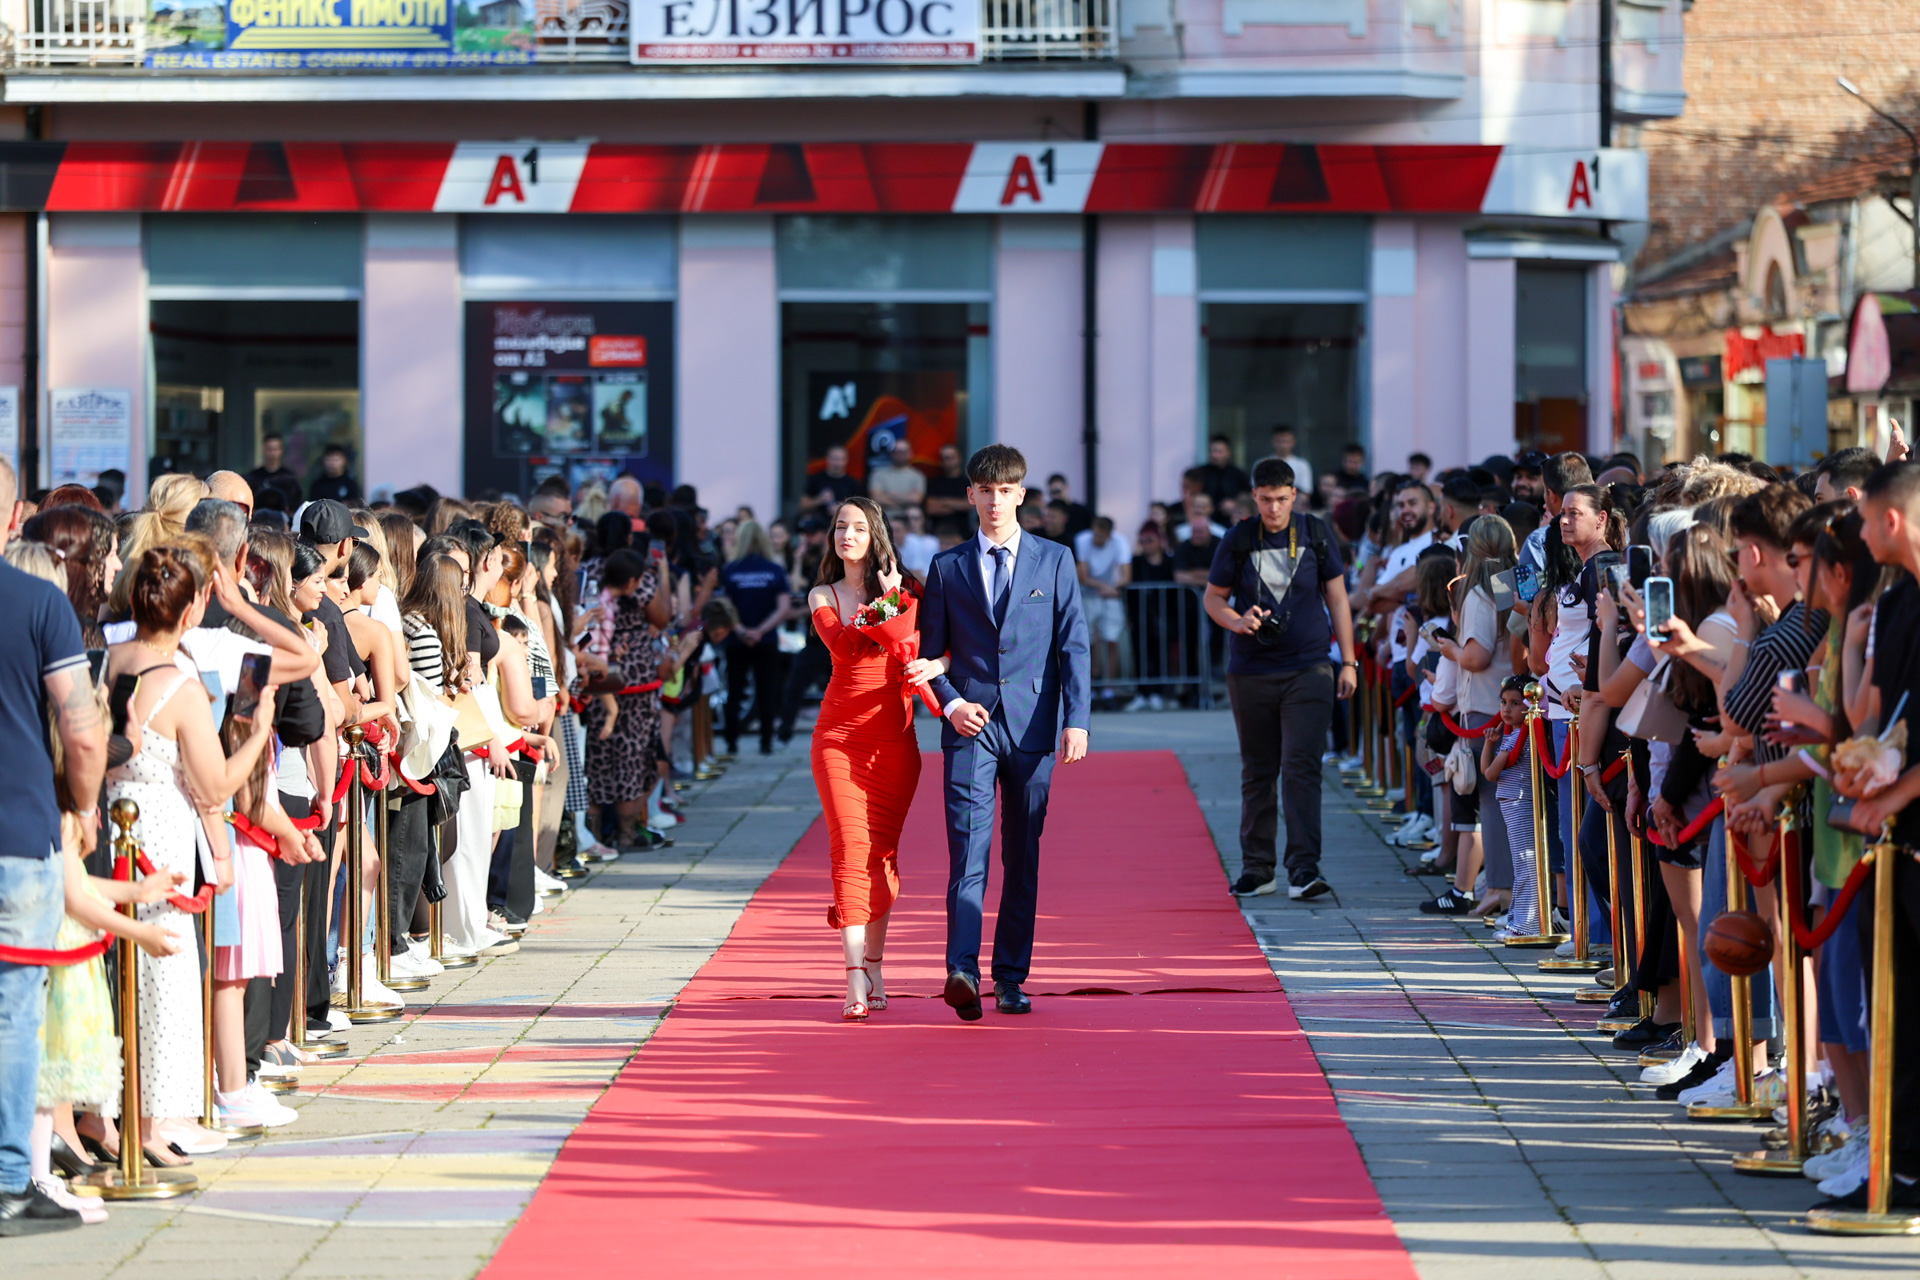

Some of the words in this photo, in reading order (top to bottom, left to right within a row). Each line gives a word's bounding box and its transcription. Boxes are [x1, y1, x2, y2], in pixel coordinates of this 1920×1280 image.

[230, 0, 342, 28] ФЕНИКС
[350, 0, 447, 26] ИМОТИ
[661, 0, 955, 37] ЕЛЗИРОС
[152, 53, 209, 68] REAL
[212, 52, 302, 68] ESTATES
[305, 52, 407, 67] COMPANY
[484, 147, 538, 206] A1
[1000, 148, 1053, 206] A1
[1567, 155, 1600, 210] A1
[819, 381, 856, 420] A1
